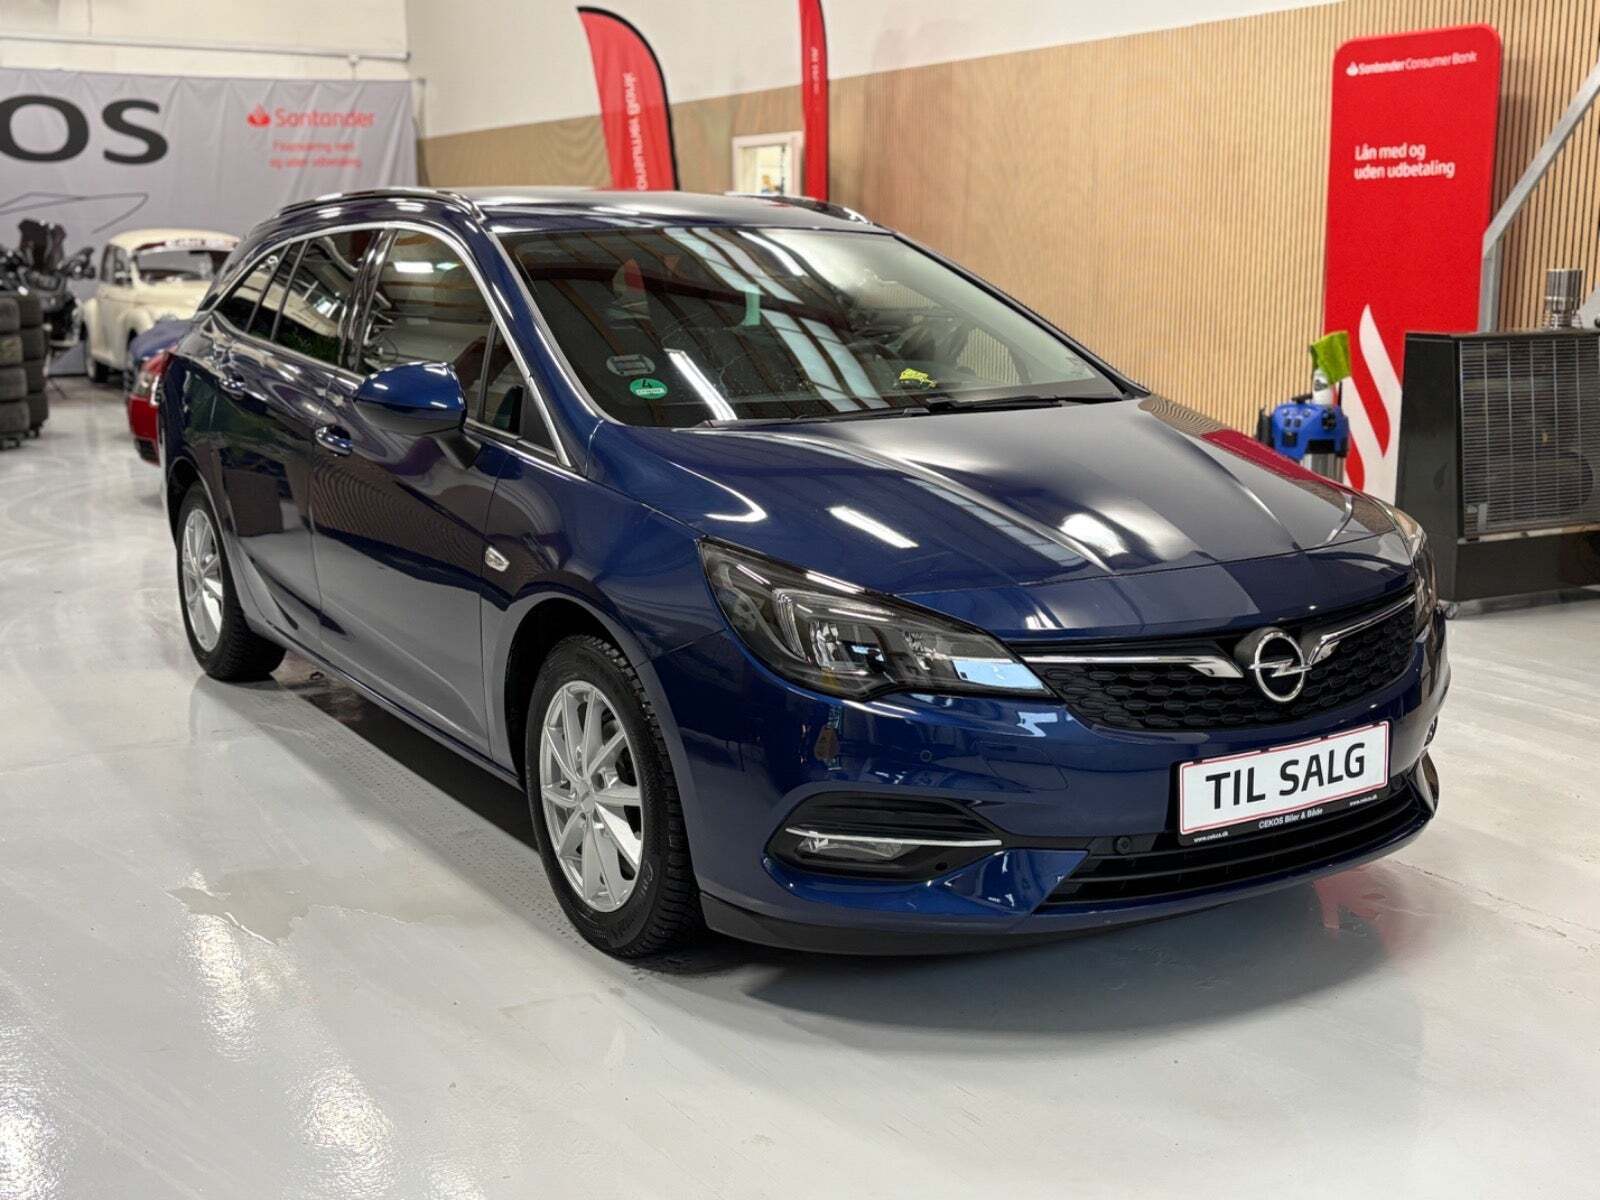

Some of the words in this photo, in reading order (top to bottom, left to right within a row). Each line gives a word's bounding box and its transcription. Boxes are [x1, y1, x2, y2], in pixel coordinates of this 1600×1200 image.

[1358, 60, 1405, 75] Santander
[1405, 55, 1451, 69] Consumer
[1452, 51, 1477, 65] Bank
[274, 106, 375, 128] Santander
[1354, 143, 1377, 161] Lån
[1378, 142, 1407, 159] med
[1408, 144, 1426, 160] og
[1354, 163, 1385, 180] uden
[1387, 160, 1455, 179] udbetaling
[1205, 766, 1266, 810] TIL
[1279, 742, 1366, 797] SALG
[1258, 817, 1284, 829] CEKOS
[1284, 813, 1300, 823] Biler
